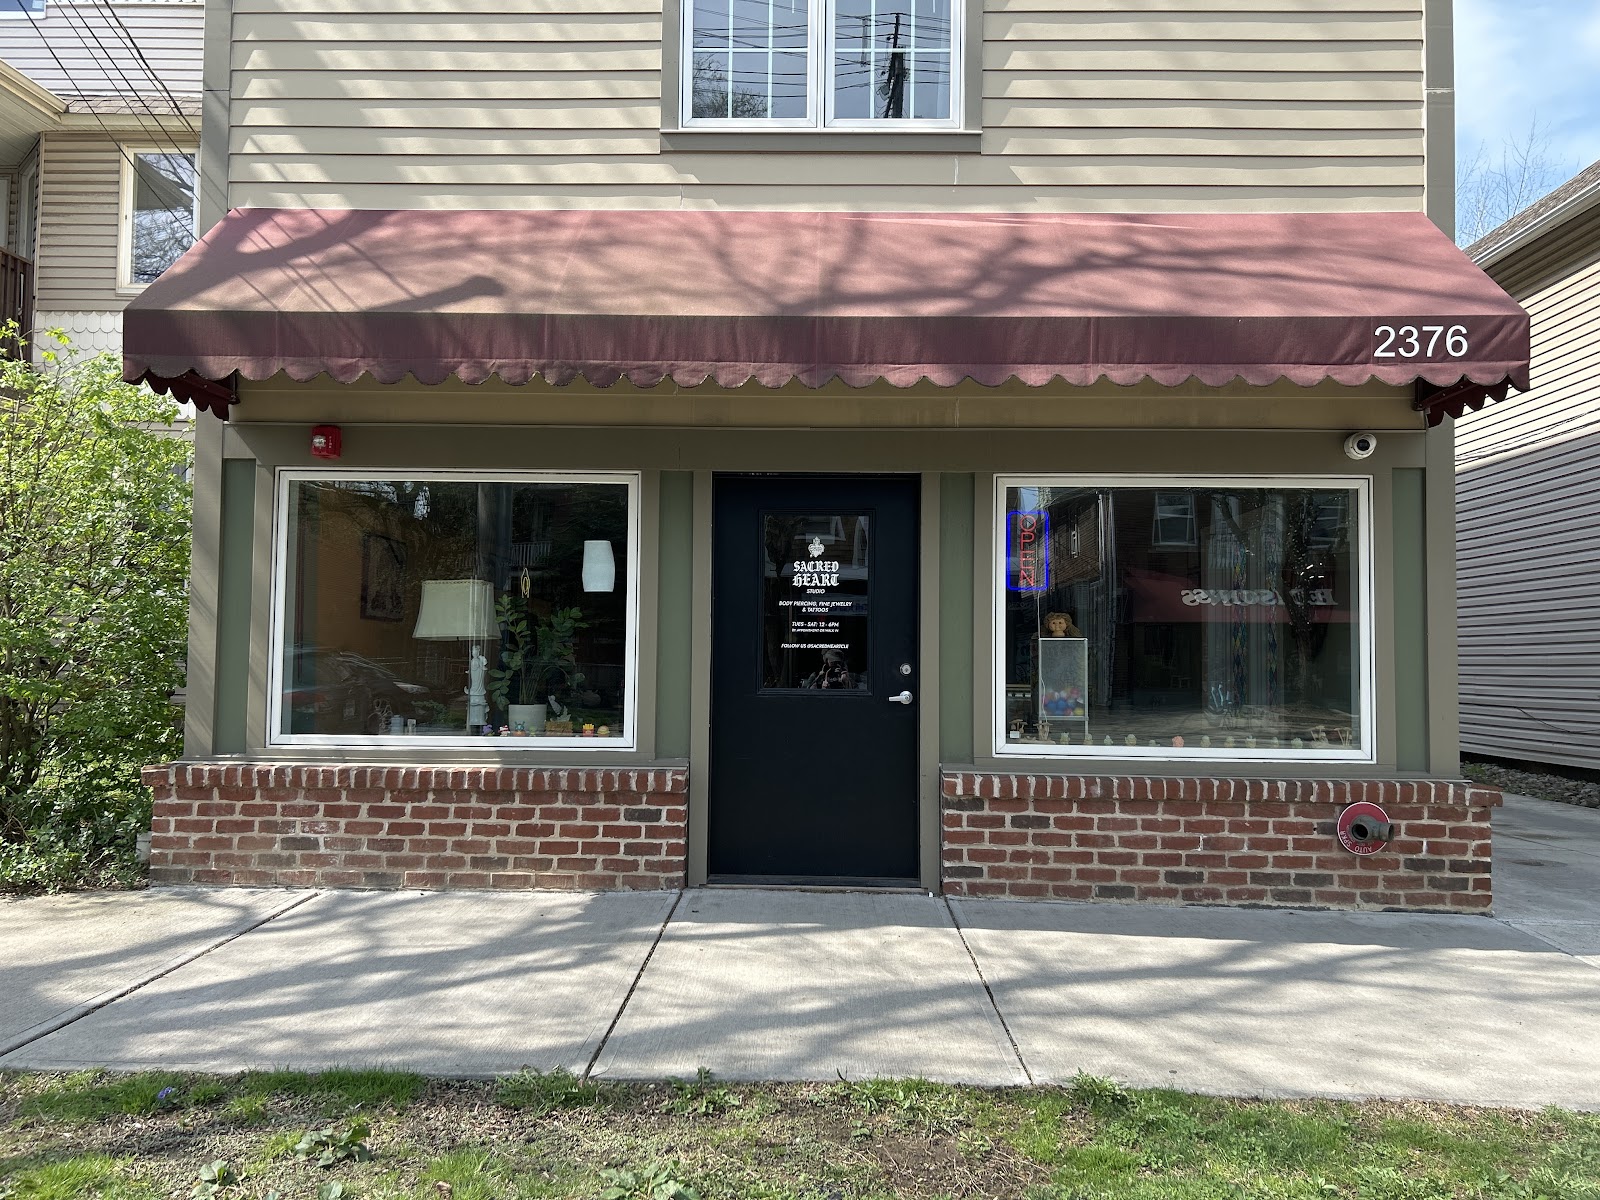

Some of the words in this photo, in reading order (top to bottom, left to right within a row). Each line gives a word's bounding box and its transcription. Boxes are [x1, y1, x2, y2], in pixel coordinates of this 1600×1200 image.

[1373, 325, 1469, 358] 2376
[1020, 515, 1037, 587] OPEN
[793, 560, 839, 572] SACRED
[792, 573, 840, 587] HEART
[1340, 830, 1353, 847] SPKR
[1354, 845, 1372, 853] AUTO
